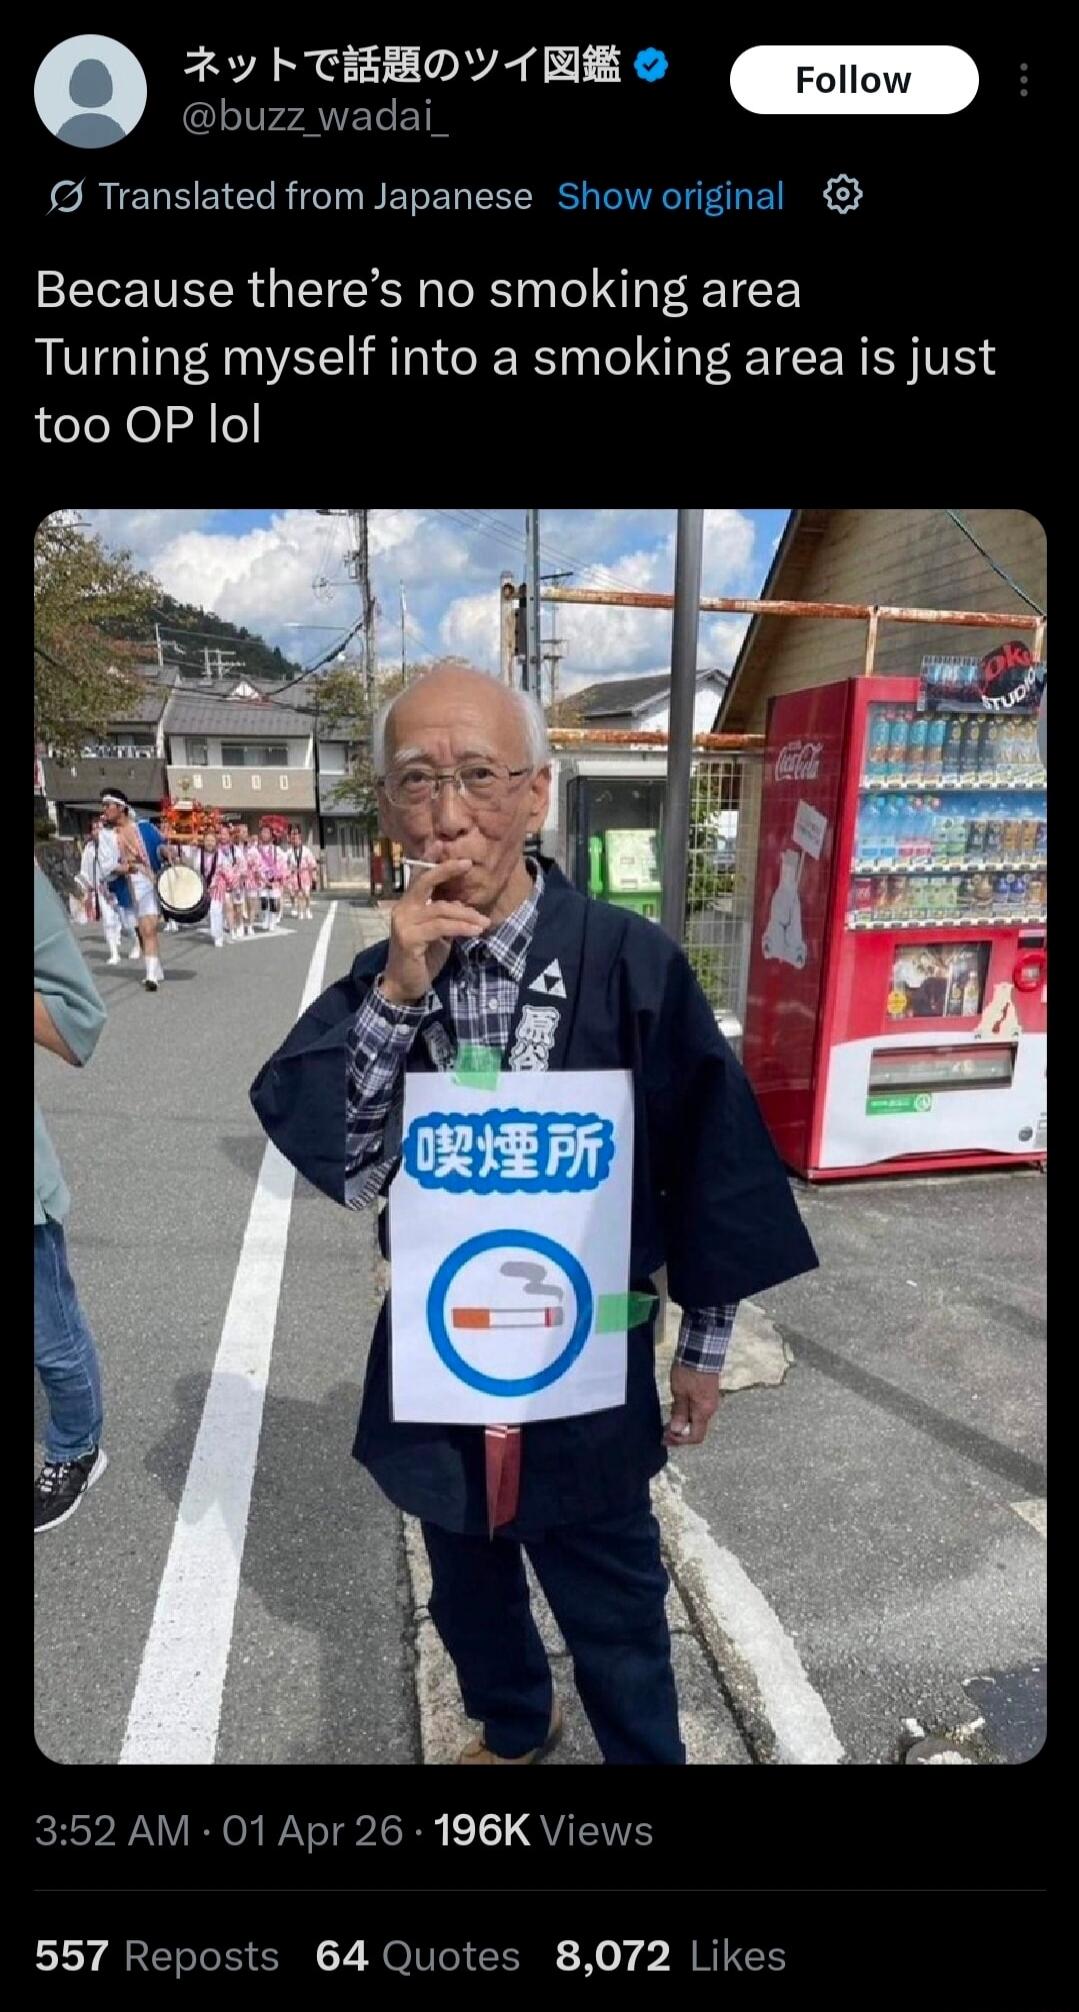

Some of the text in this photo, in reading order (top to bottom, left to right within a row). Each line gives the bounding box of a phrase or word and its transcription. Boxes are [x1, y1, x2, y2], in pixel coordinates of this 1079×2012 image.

[981, 665, 1036, 711] STUDIO
[415, 1121, 604, 1179] 喫煙所
